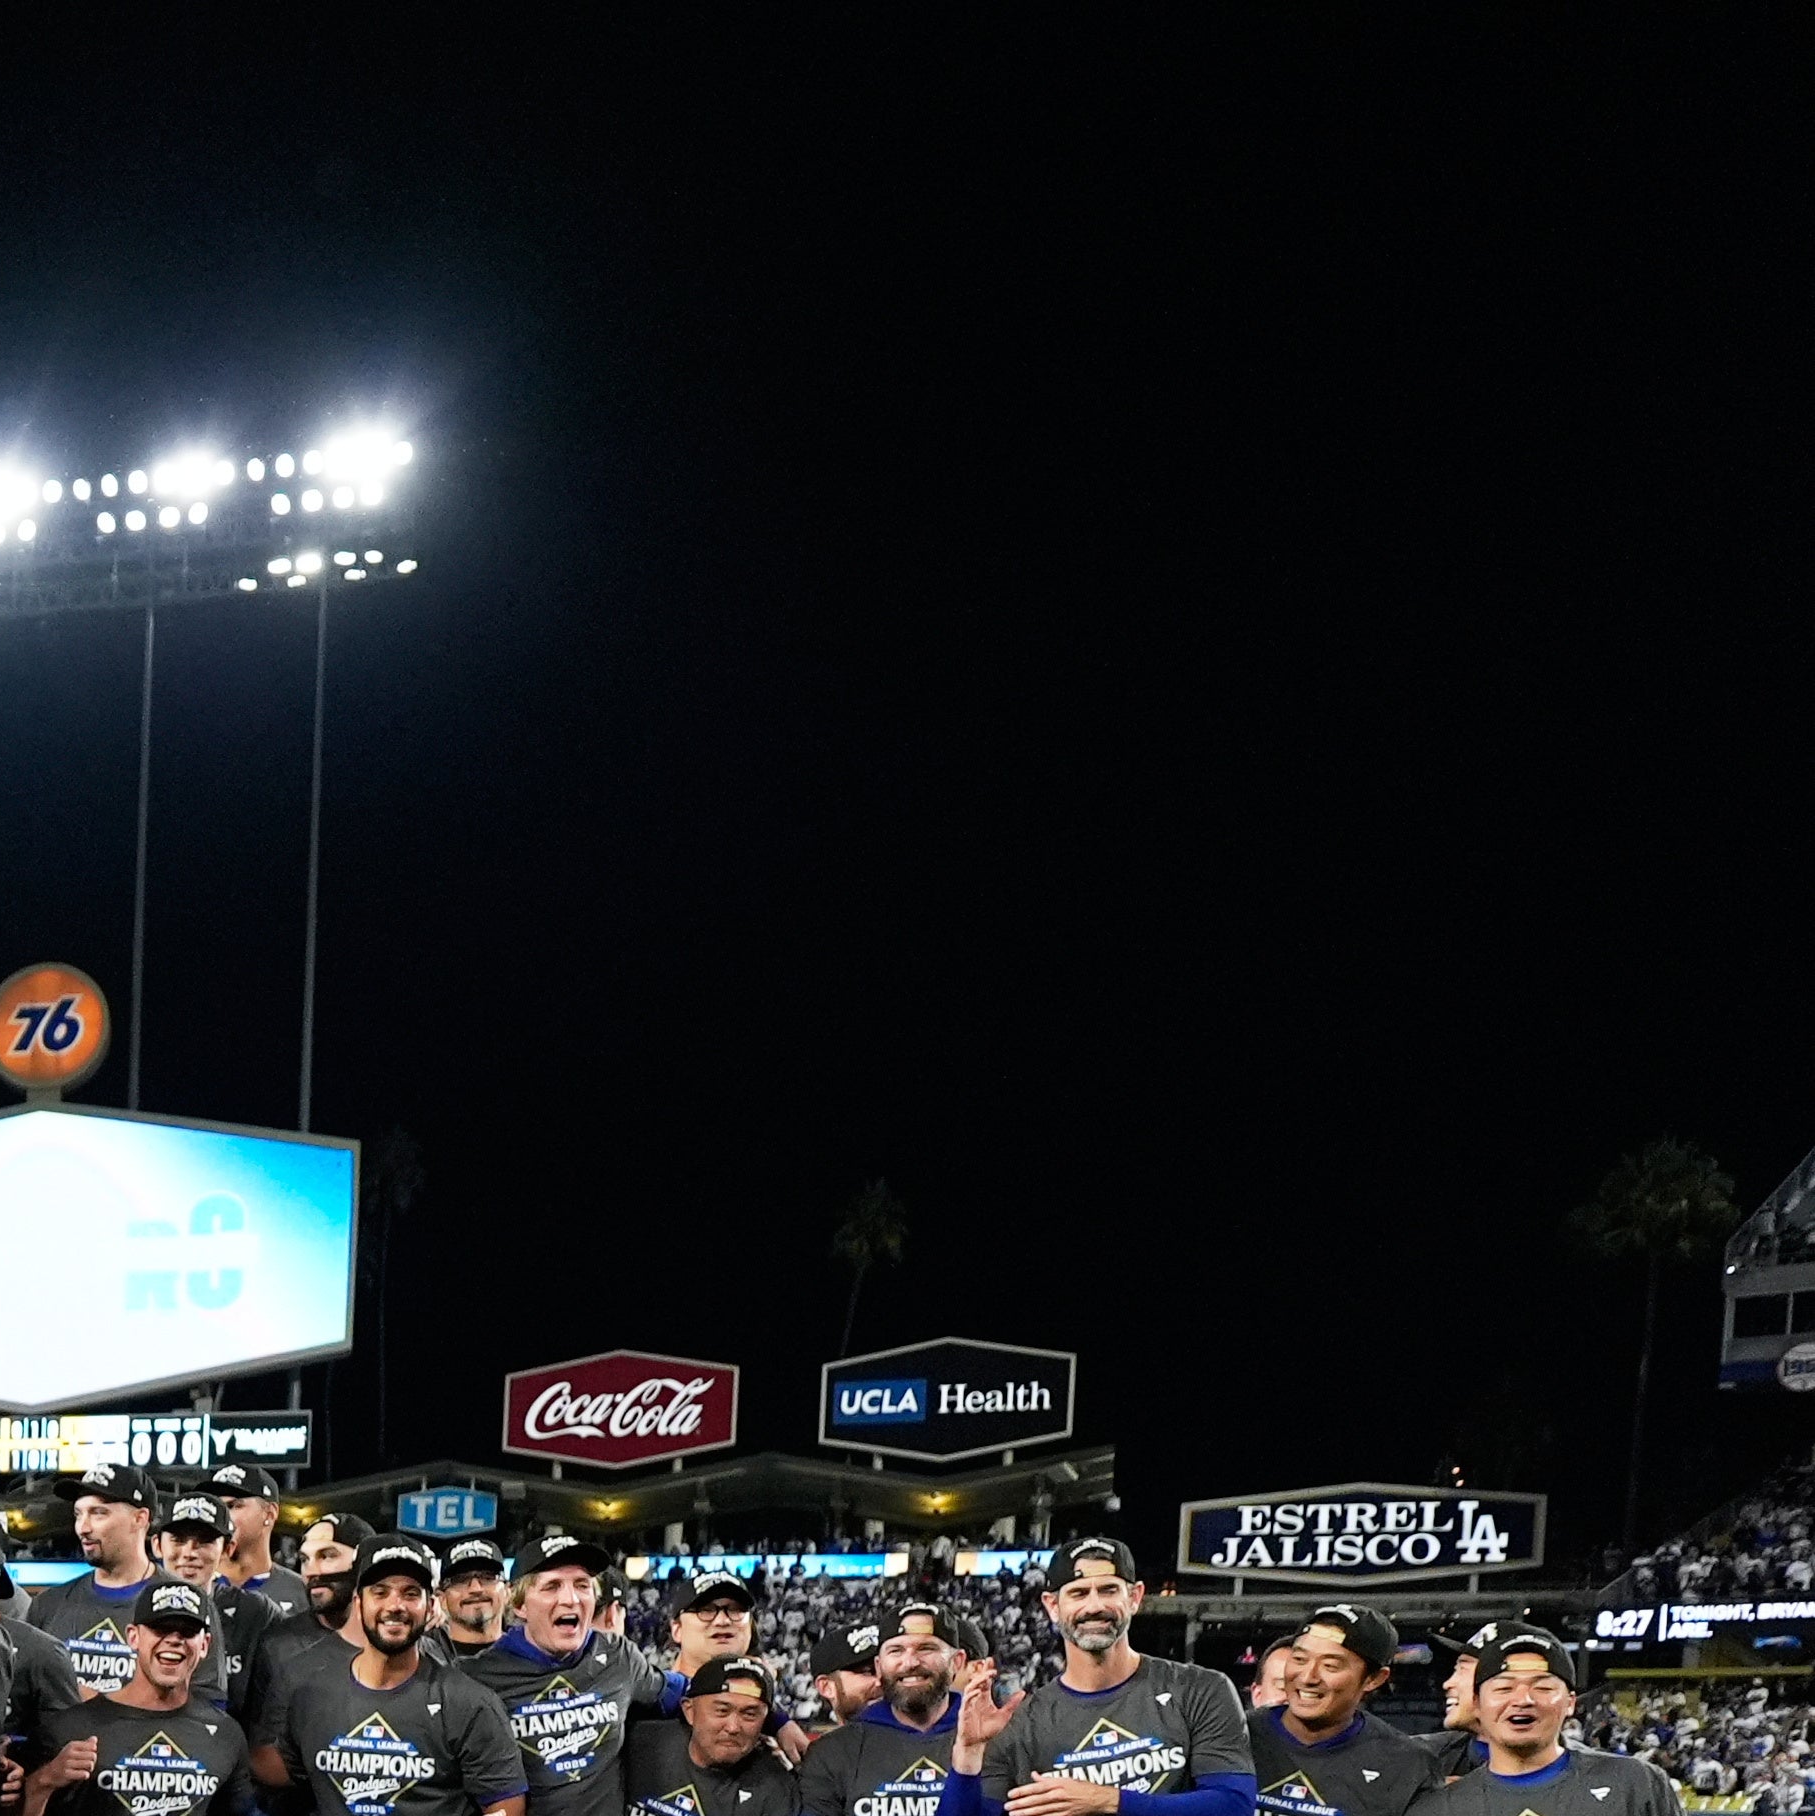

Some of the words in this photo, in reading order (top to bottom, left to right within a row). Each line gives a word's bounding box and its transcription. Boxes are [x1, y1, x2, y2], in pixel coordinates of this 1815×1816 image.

[6, 993, 86, 1058] 76
[524, 1376, 716, 1440] Coca-Cola
[839, 1387, 920, 1416] UCLA
[937, 1380, 1052, 1415] Health
[408, 1493, 481, 1527] TEL
[1236, 1500, 1454, 1537] ESTREL
[1210, 1533, 1441, 1568] JALISCO
[1595, 1608, 1655, 1637] 8:27
[71, 1654, 136, 1678] AMPIO
[511, 1701, 619, 1738] HAMPIONS
[537, 1726, 600, 1761] Dodgers
[315, 1750, 436, 1779] CHAMPIONS
[97, 1769, 219, 1796] CHAMPIONS
[343, 1777, 401, 1803] Dodgers
